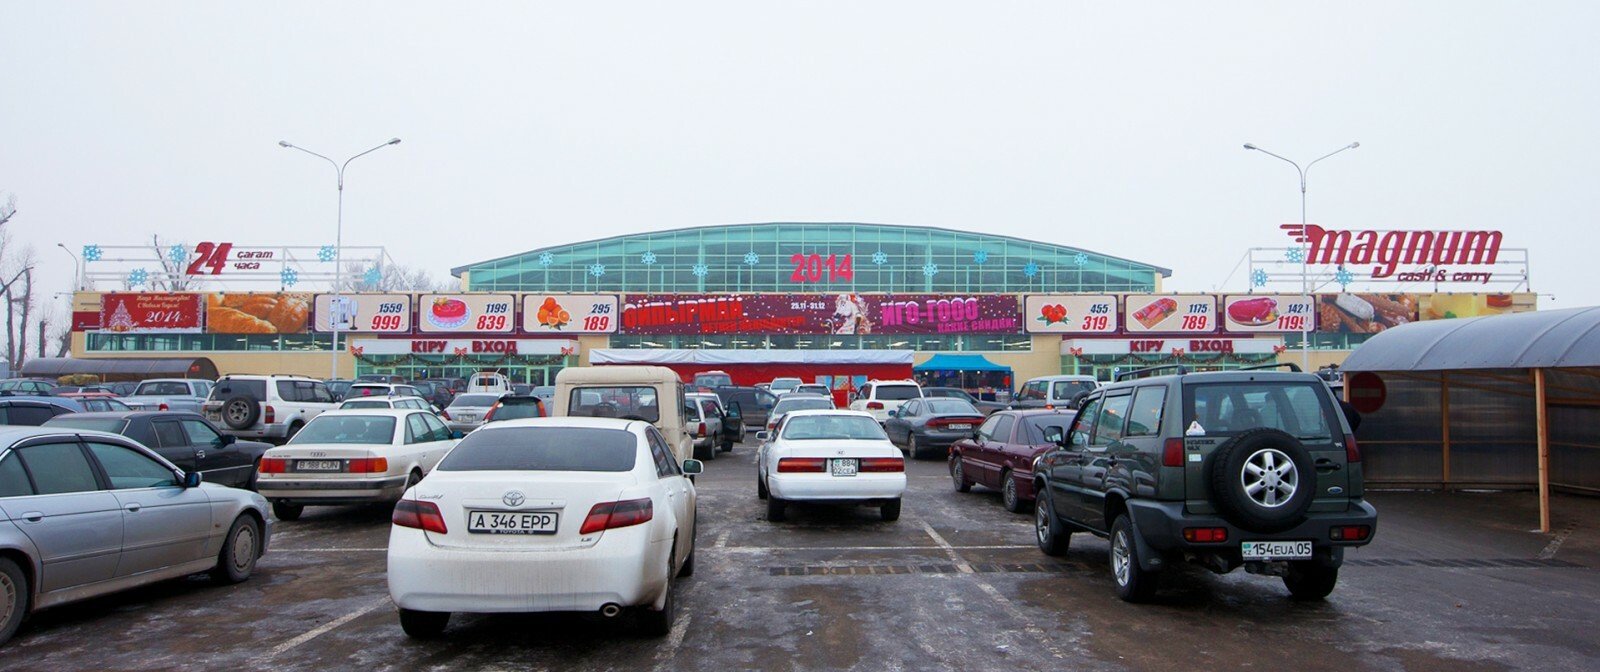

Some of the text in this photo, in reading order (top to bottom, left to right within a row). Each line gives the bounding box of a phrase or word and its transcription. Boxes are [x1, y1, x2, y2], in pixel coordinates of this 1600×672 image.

[186, 241, 233, 275] 24
[1281, 224, 1503, 278] magnum
[234, 261, 261, 270] часа
[790, 252, 853, 283] 2014
[1397, 269, 1493, 285] cash & carry
[379, 303, 403, 314] 1559
[485, 303, 507, 314] 1199
[591, 304, 610, 314] 295
[1090, 303, 1109, 314] 455
[1188, 303, 1208, 314] 1175
[144, 311, 181, 323] 2014
[371, 315, 401, 330] 999
[476, 315, 506, 330] 839
[583, 316, 609, 331] 189
[1082, 316, 1107, 330] 319
[1181, 315, 1207, 330] 789
[411, 340, 518, 354] КІРУ ВХОД
[1129, 340, 1233, 354] КІРУ ВХОД
[475, 514, 551, 529] A 346 EPP
[1296, 543, 1311, 555] 05
